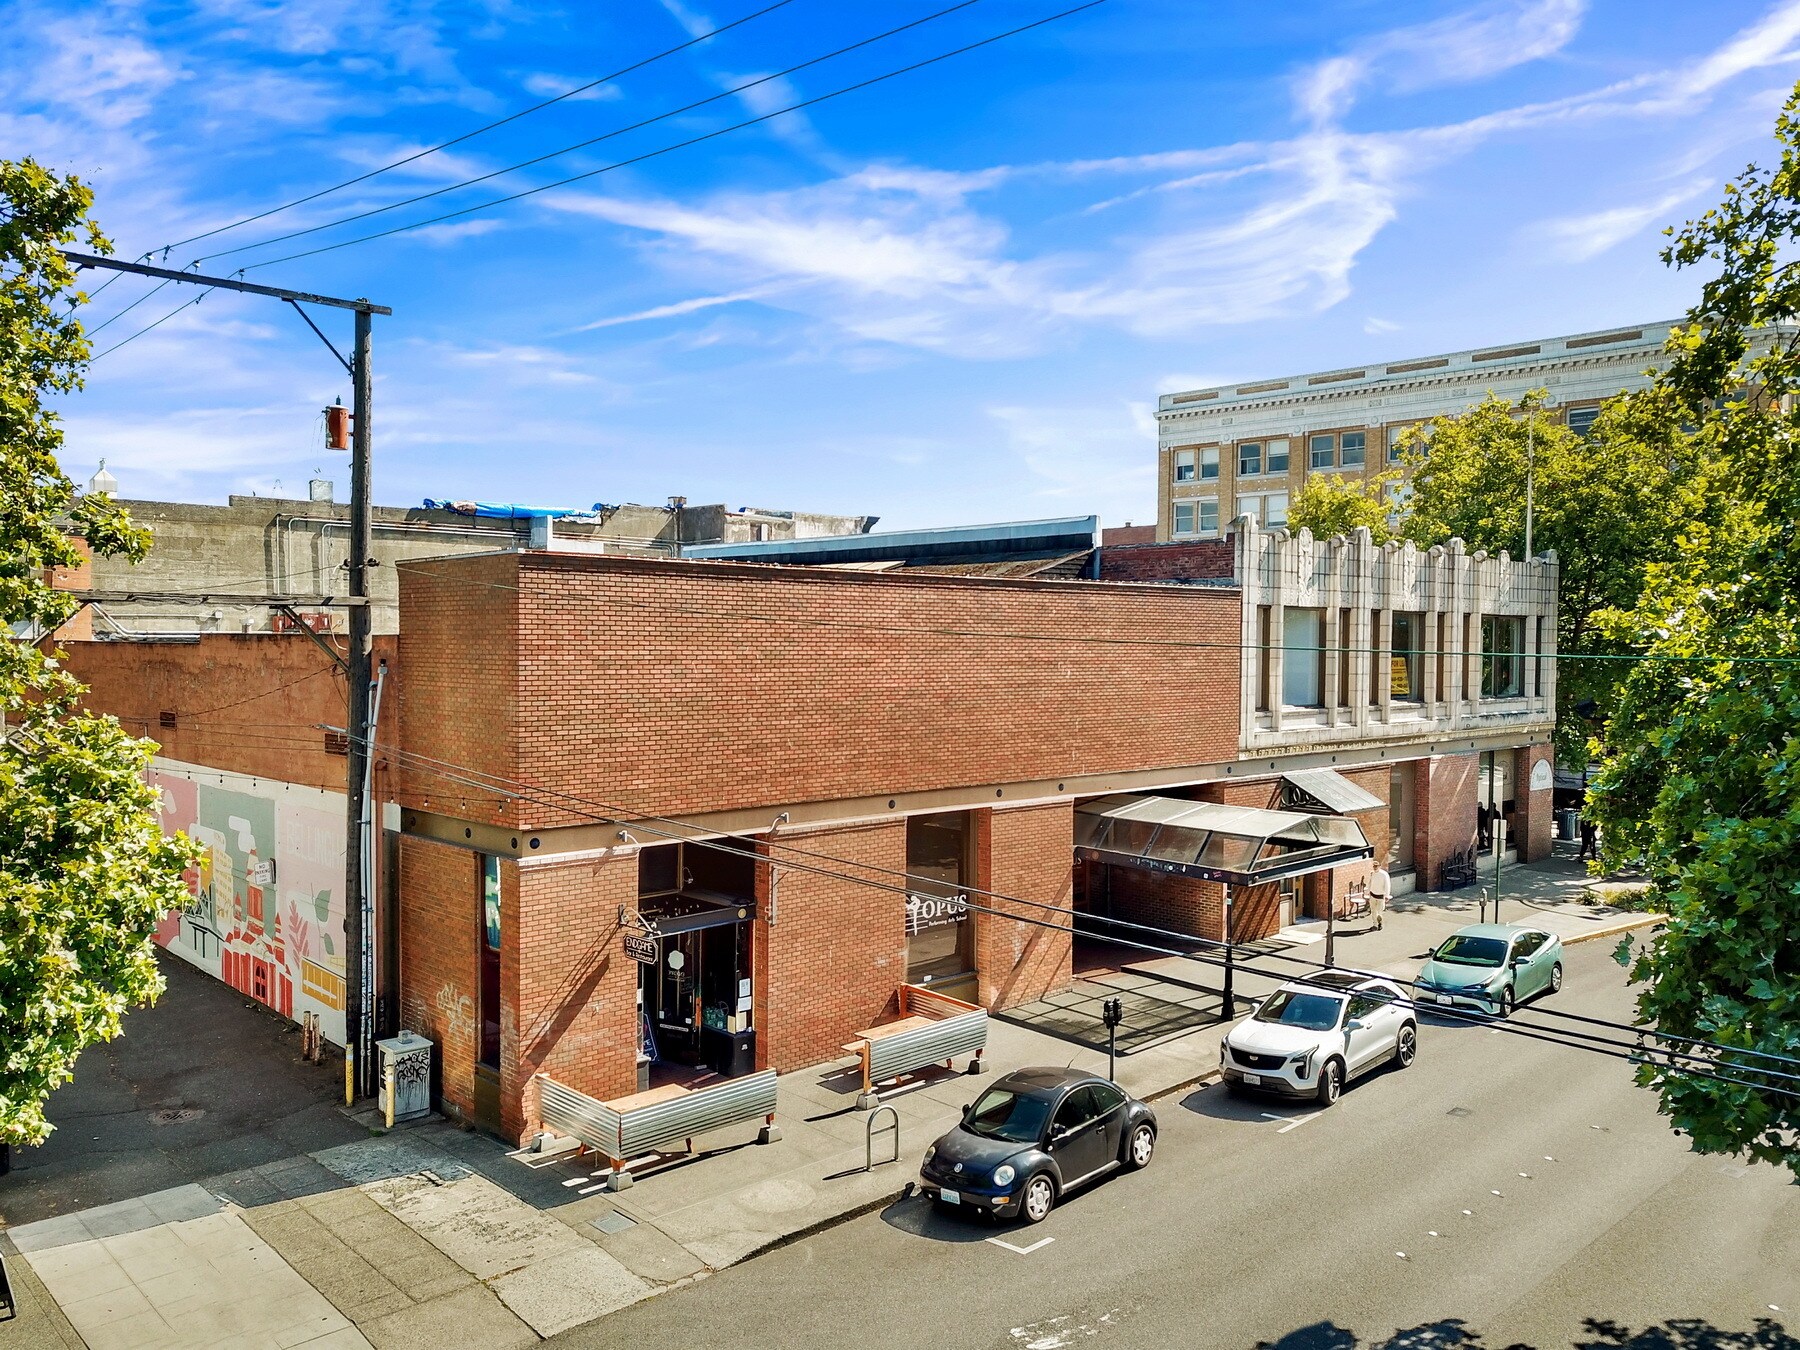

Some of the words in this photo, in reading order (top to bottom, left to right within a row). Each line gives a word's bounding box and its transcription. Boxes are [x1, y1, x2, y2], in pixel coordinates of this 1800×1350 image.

[922, 894, 967, 919] OPUS
[928, 919, 948, 927] Performing
[626, 937, 653, 953] ENDGAME
